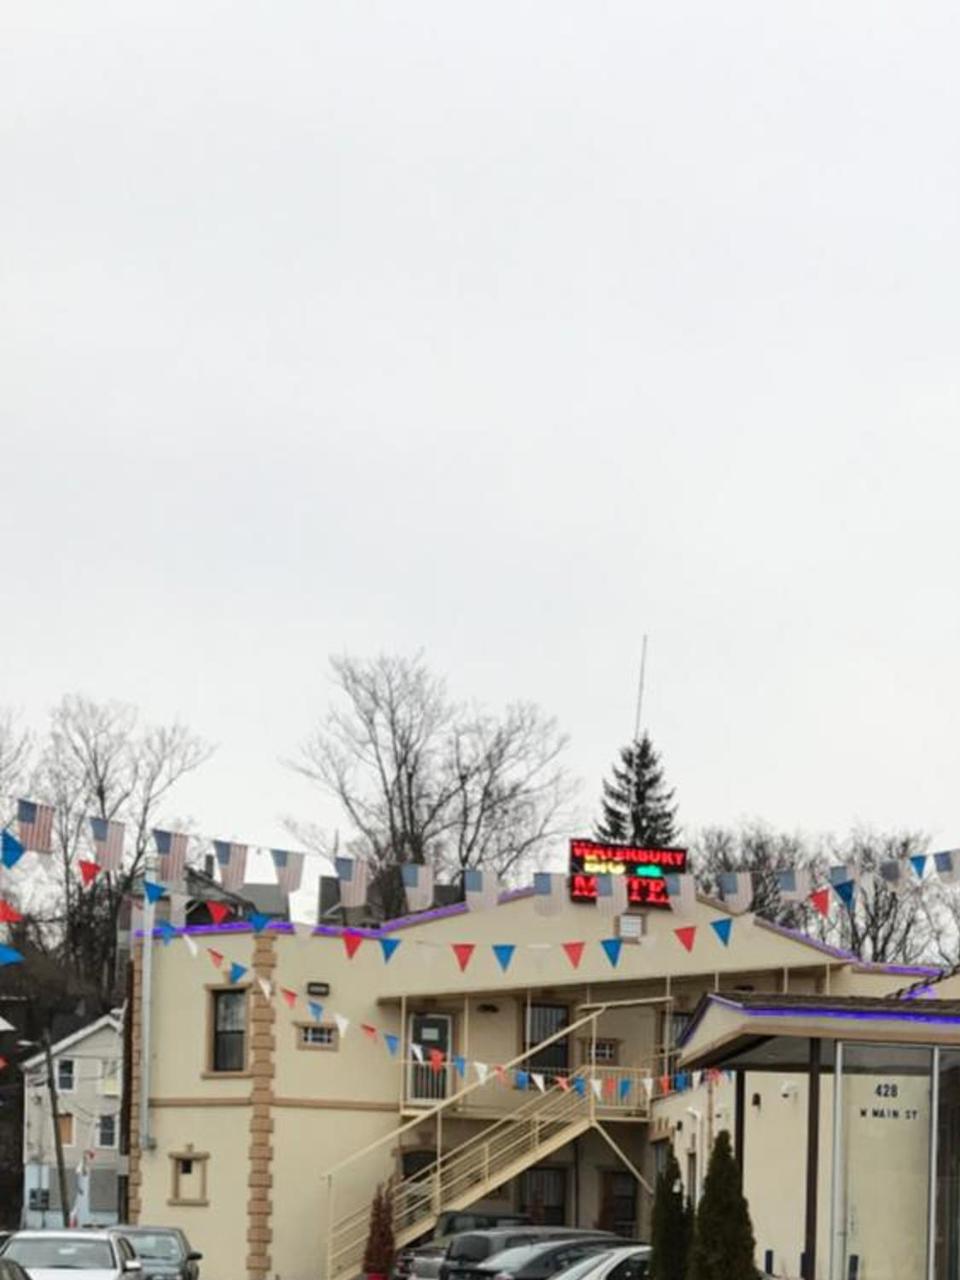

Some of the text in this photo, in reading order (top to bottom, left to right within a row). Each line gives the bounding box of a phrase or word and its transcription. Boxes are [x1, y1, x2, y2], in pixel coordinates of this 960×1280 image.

[875, 1083, 898, 1098] 428
[872, 1109, 899, 1119] MAIN
[905, 1109, 918, 1120] ST
